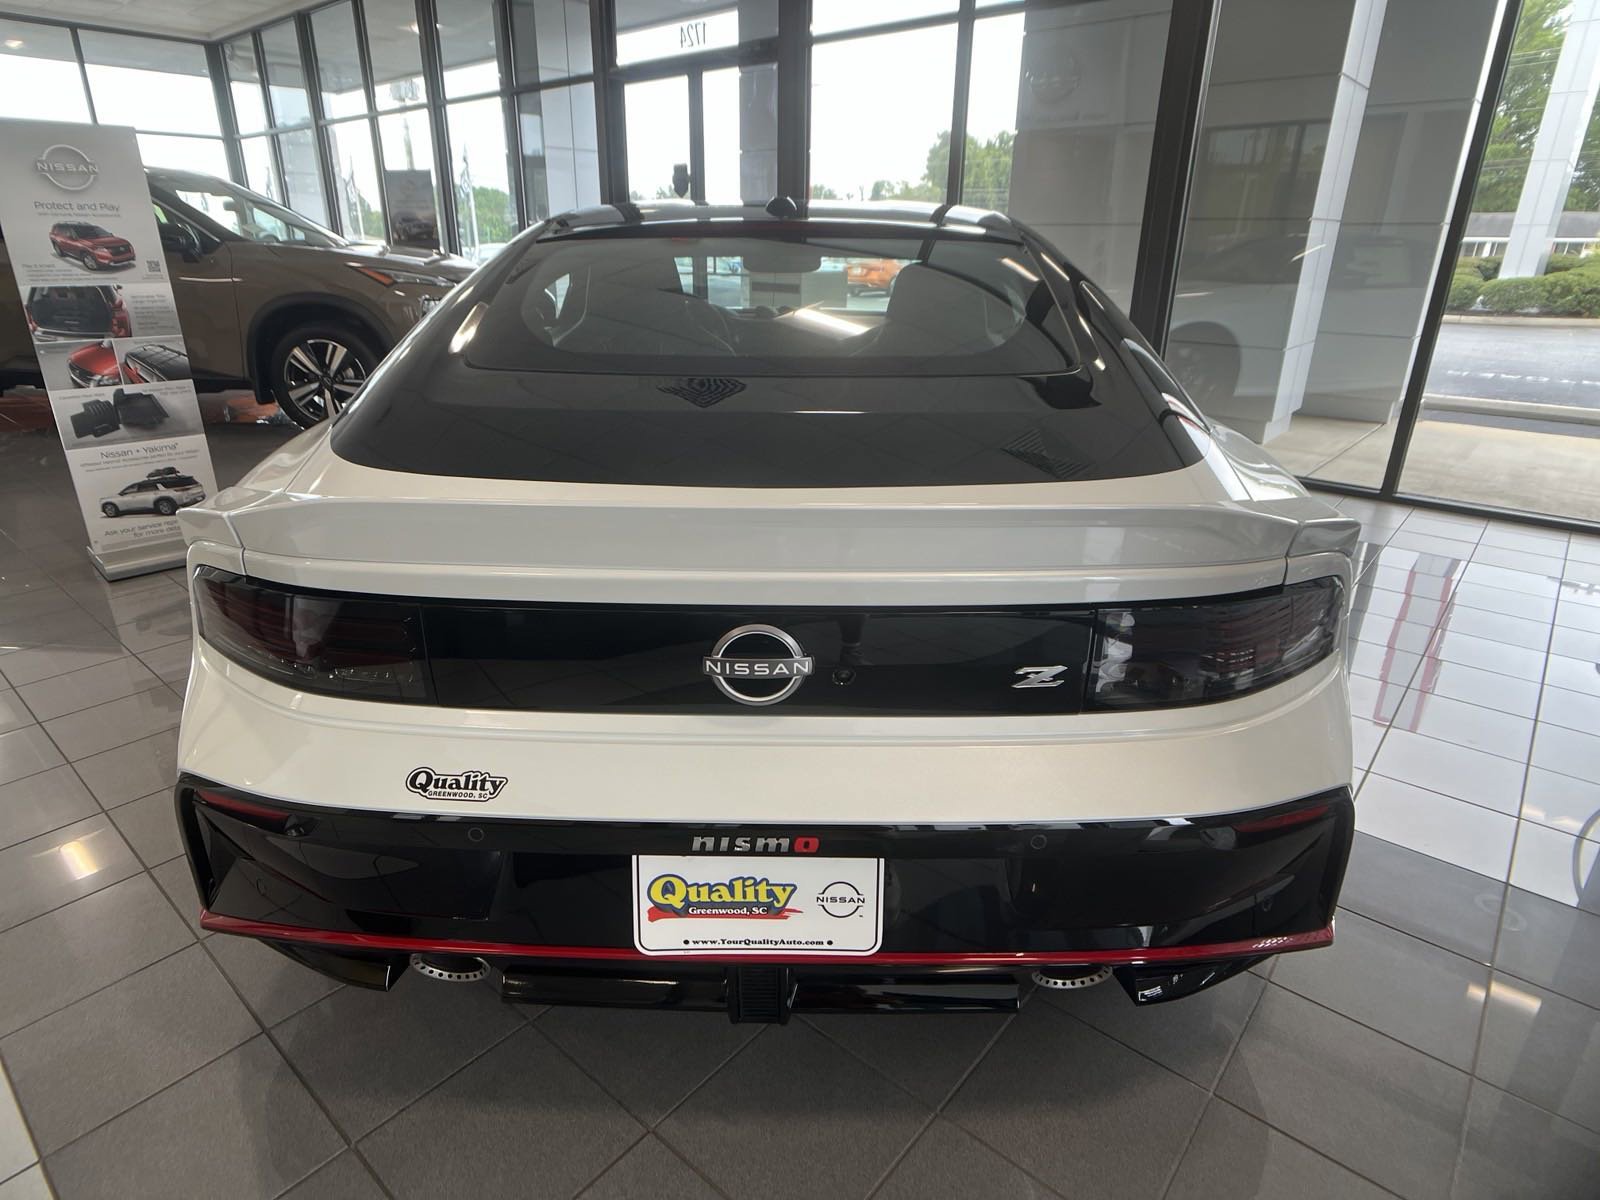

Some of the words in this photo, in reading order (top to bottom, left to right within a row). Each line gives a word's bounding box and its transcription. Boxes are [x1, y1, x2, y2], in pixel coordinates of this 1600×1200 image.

[36, 162, 98, 174] NISSAN
[33, 200, 74, 210] Protect
[76, 202, 97, 211] and
[99, 203, 120, 213] Play
[100, 449, 134, 459] Nissan
[705, 660, 809, 676] NISSAN
[1011, 665, 1068, 688] Z
[409, 770, 505, 795] Quality
[428, 790, 476, 799] GREENWOOD,
[692, 836, 819, 852] nismo
[649, 875, 796, 909] Quality
[816, 896, 865, 904] NISSAN
[688, 906, 750, 916] Greenwood,
[751, 906, 768, 914] SC
[692, 938, 824, 946] www.YourQualityAuto.com
